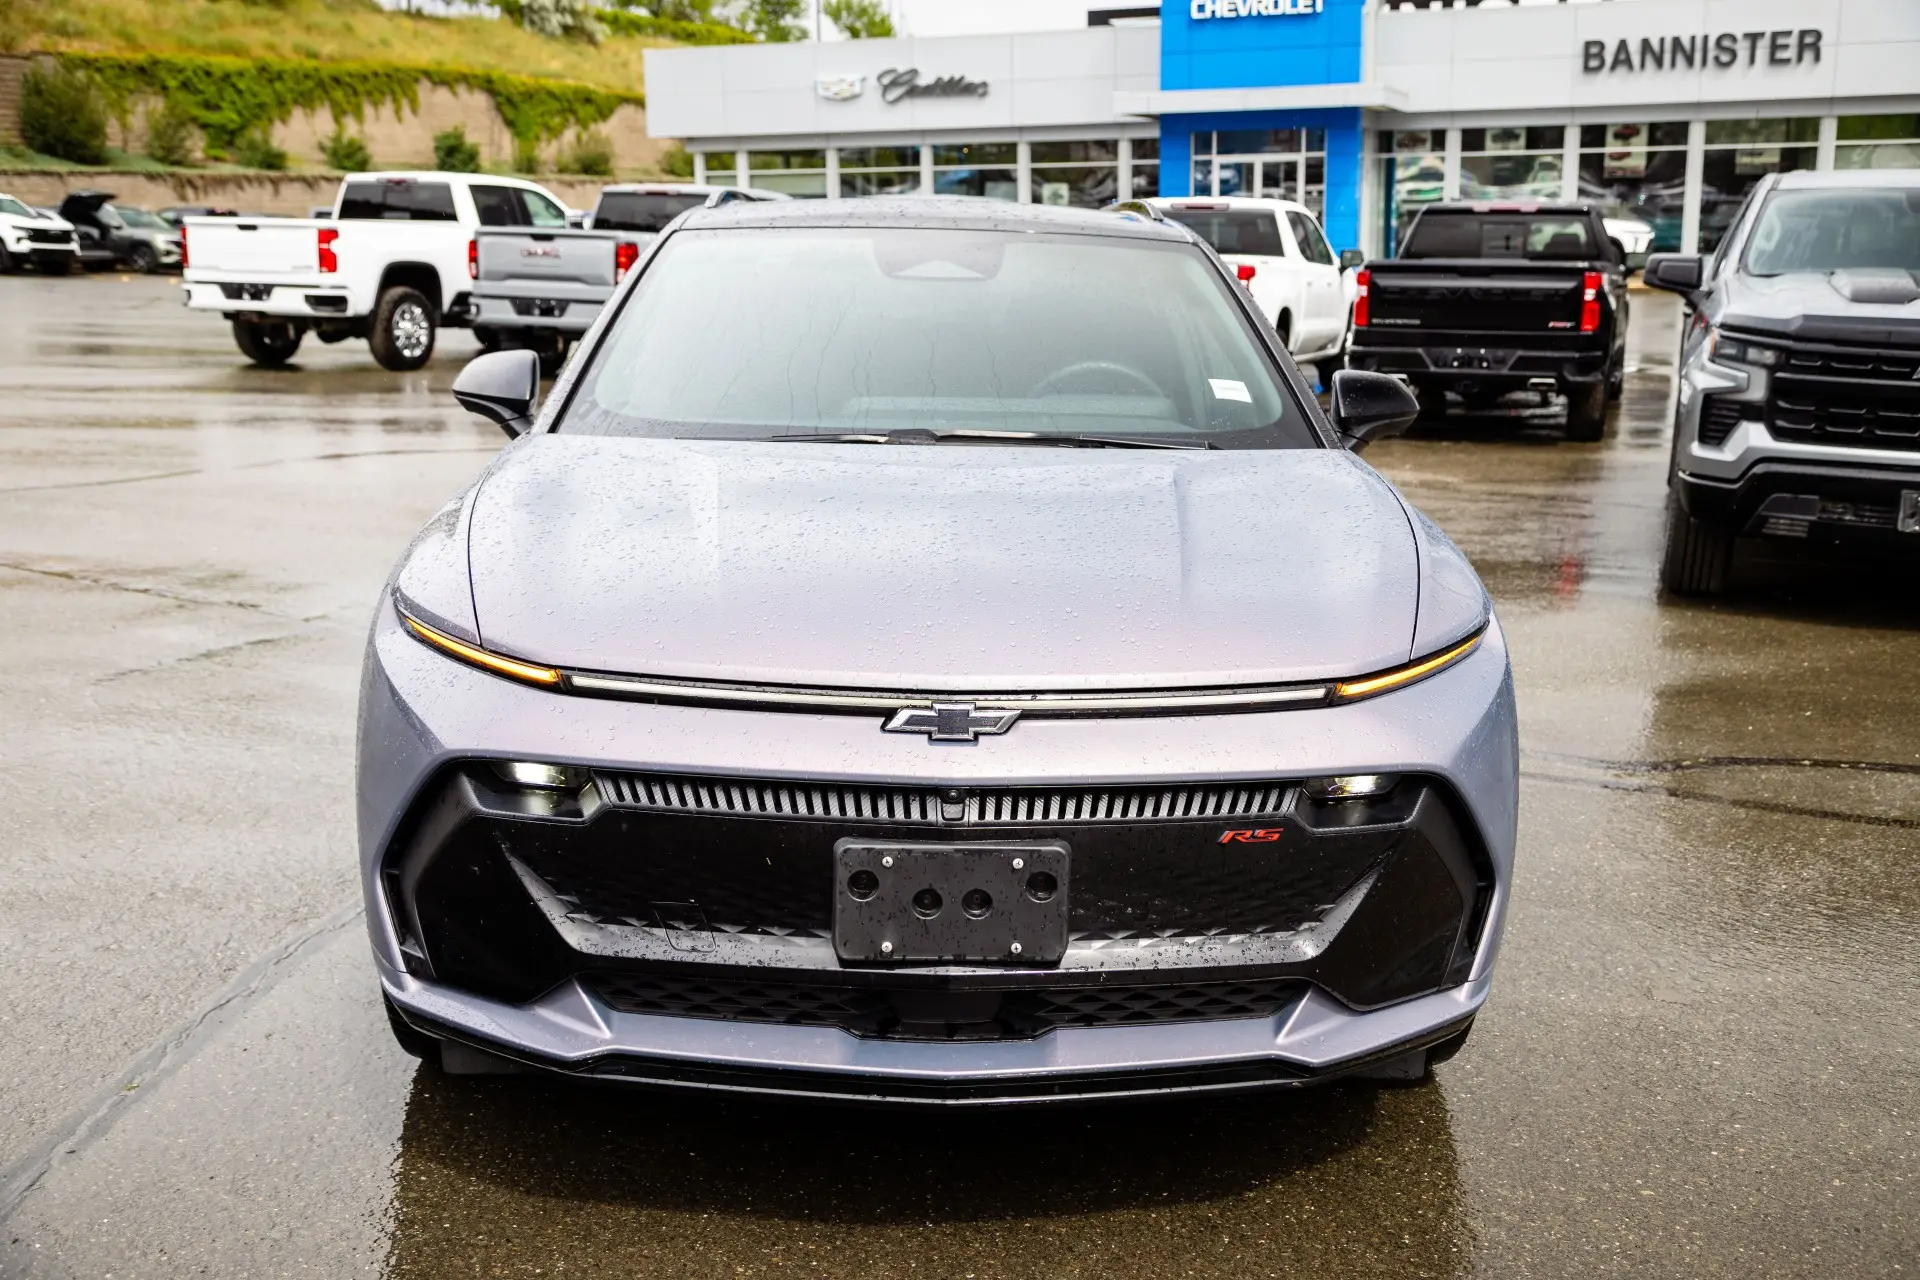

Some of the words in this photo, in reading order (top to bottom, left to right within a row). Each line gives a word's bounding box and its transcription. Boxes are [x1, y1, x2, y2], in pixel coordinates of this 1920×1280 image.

[1190, 0, 1324, 20] CHEVROLET
[1583, 29, 1822, 73] BANNISTER
[1218, 828, 1284, 844] RS
